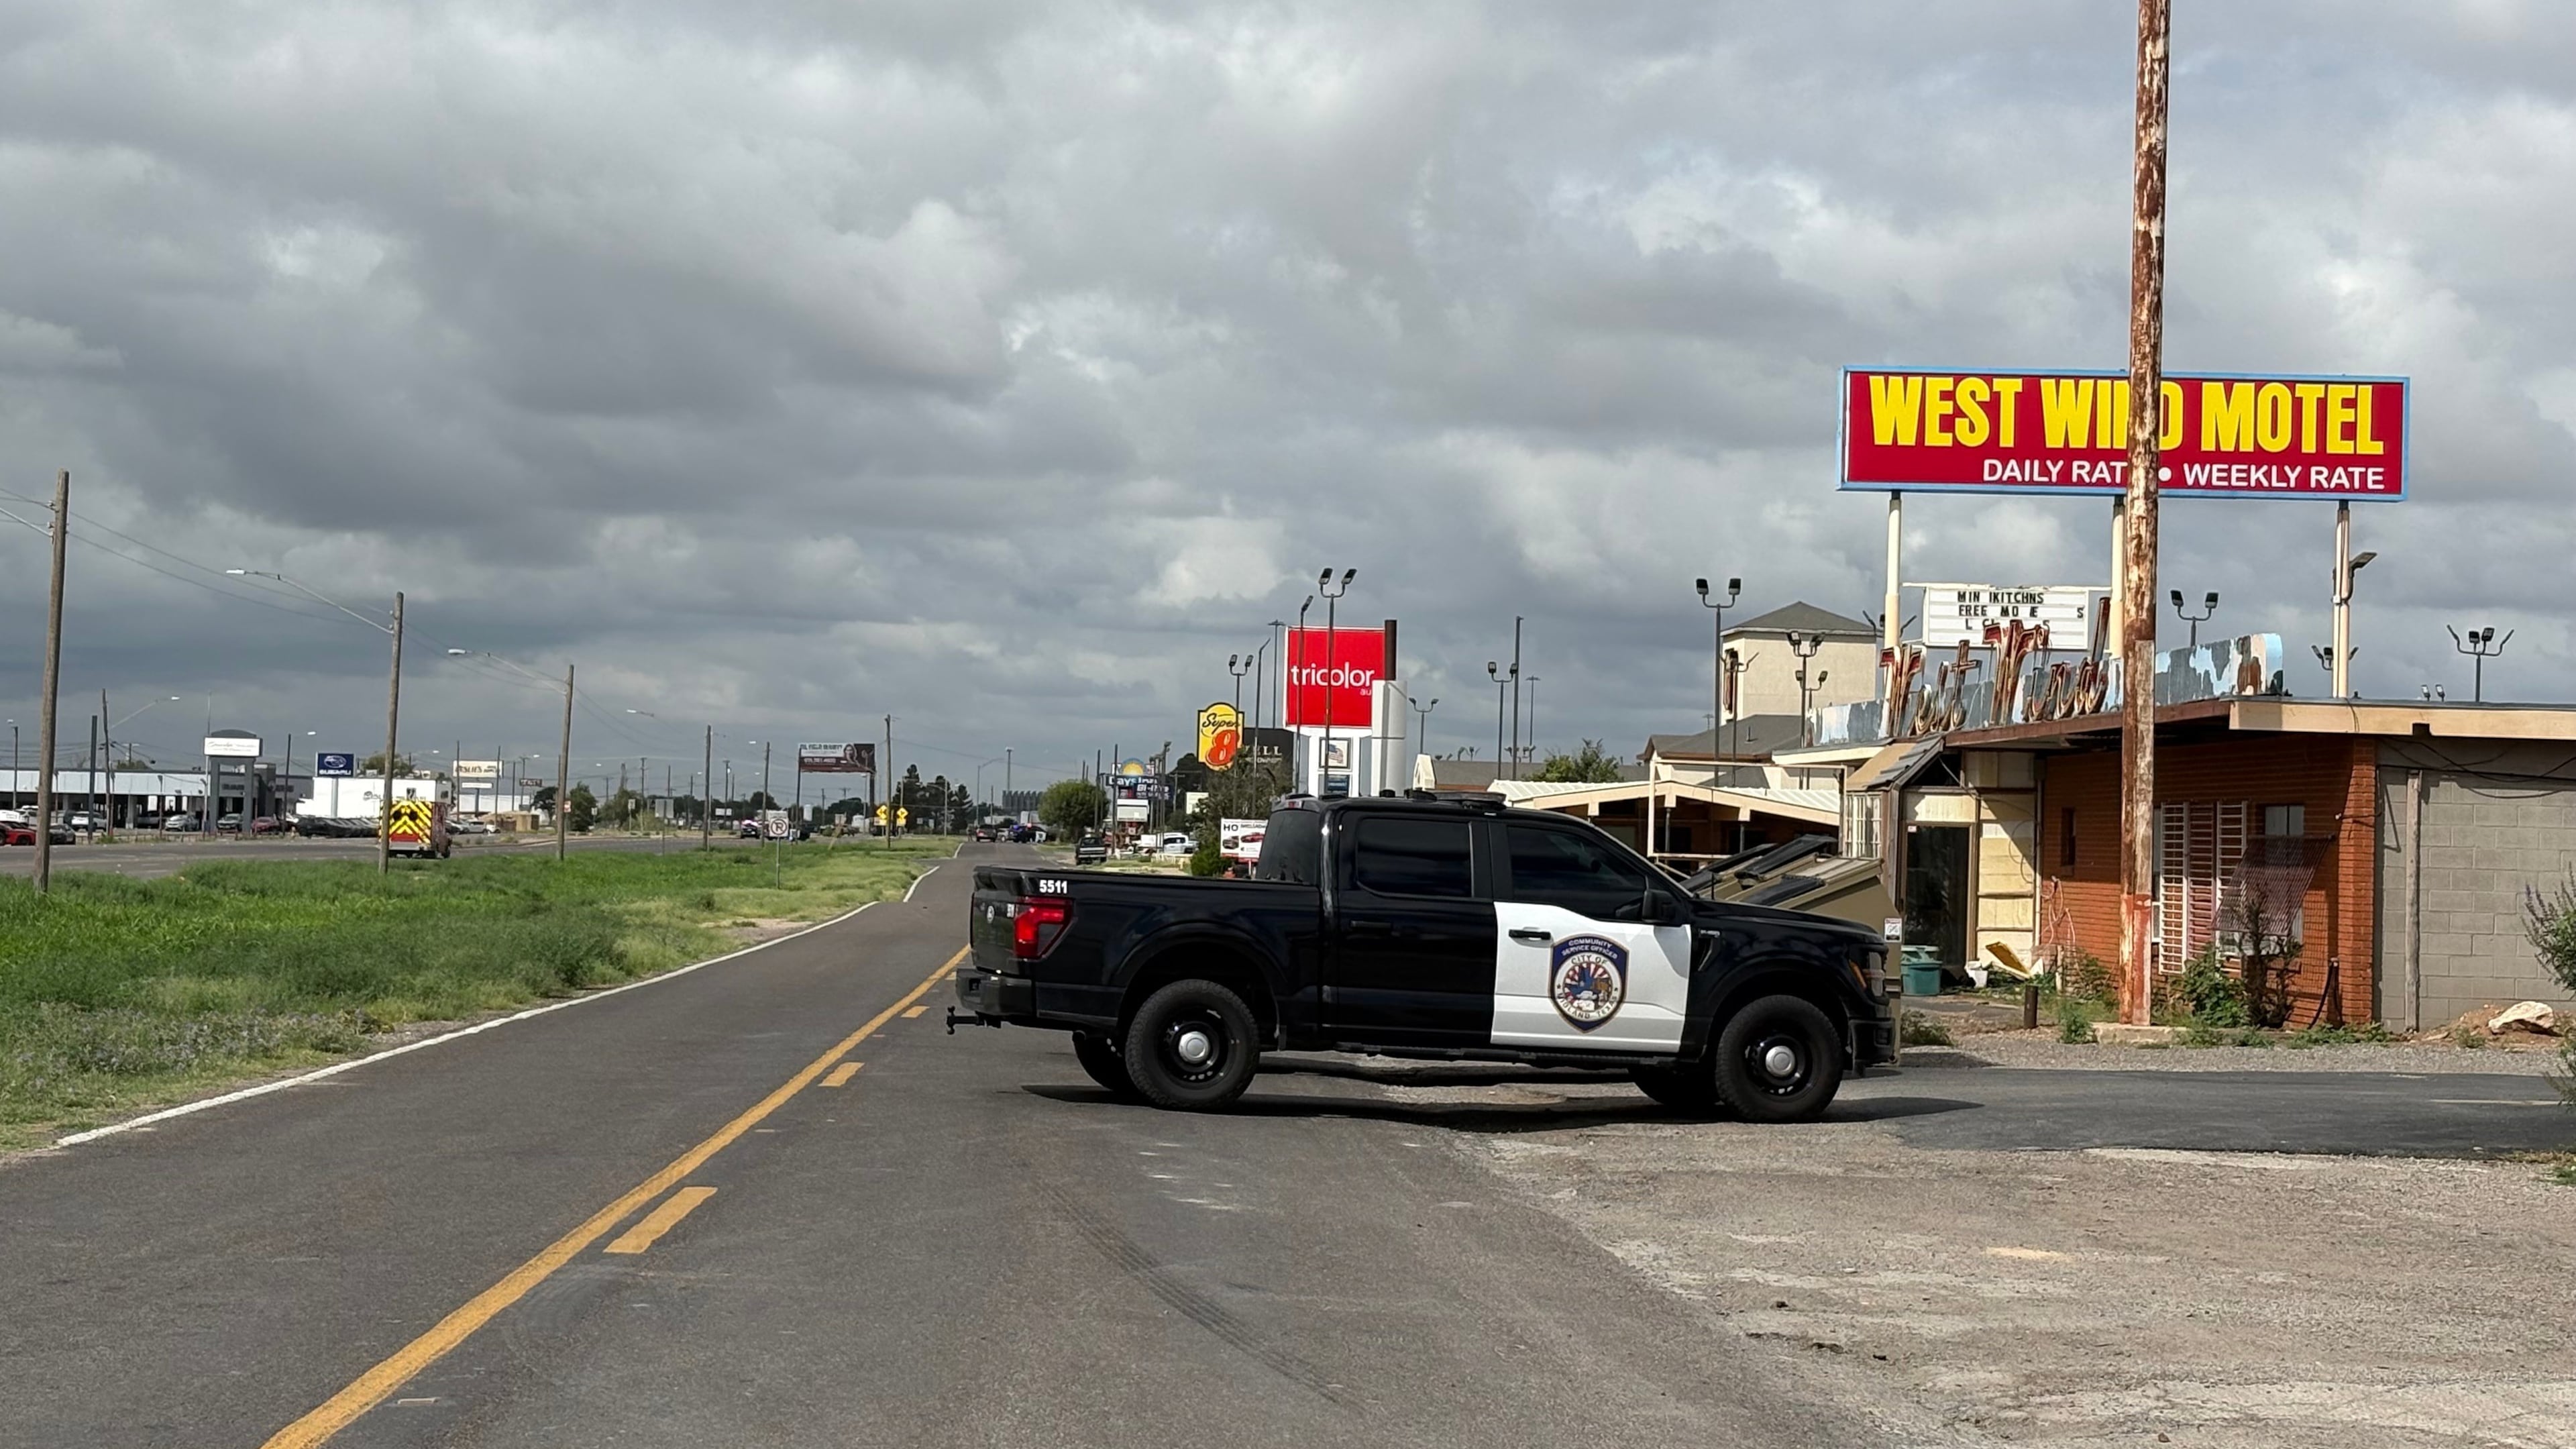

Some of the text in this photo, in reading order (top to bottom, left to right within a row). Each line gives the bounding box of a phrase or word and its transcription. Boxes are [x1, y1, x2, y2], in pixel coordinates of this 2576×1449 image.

[1868, 375, 2023, 448] WEST
[2200, 382, 2385, 455] MOTEL
[1982, 459, 2385, 490] DAILY RAT WEEKLY RATE
[1957, 591, 1980, 603] MIN
[1958, 604, 1988, 616] FREE
[1291, 661, 1375, 690] tricolor
[1360, 688, 1372, 696] au
[1201, 712, 1240, 735] Super
[1205, 729, 1240, 766] 8
[1039, 879, 1068, 894] 5511
[1568, 938, 1613, 949] COMMUNITY
[1561, 945, 1618, 960] SERVICE OFFICER
[1571, 954, 1608, 965] CITY OF
[1557, 993, 1617, 1019] MIDLAND TEXAS
